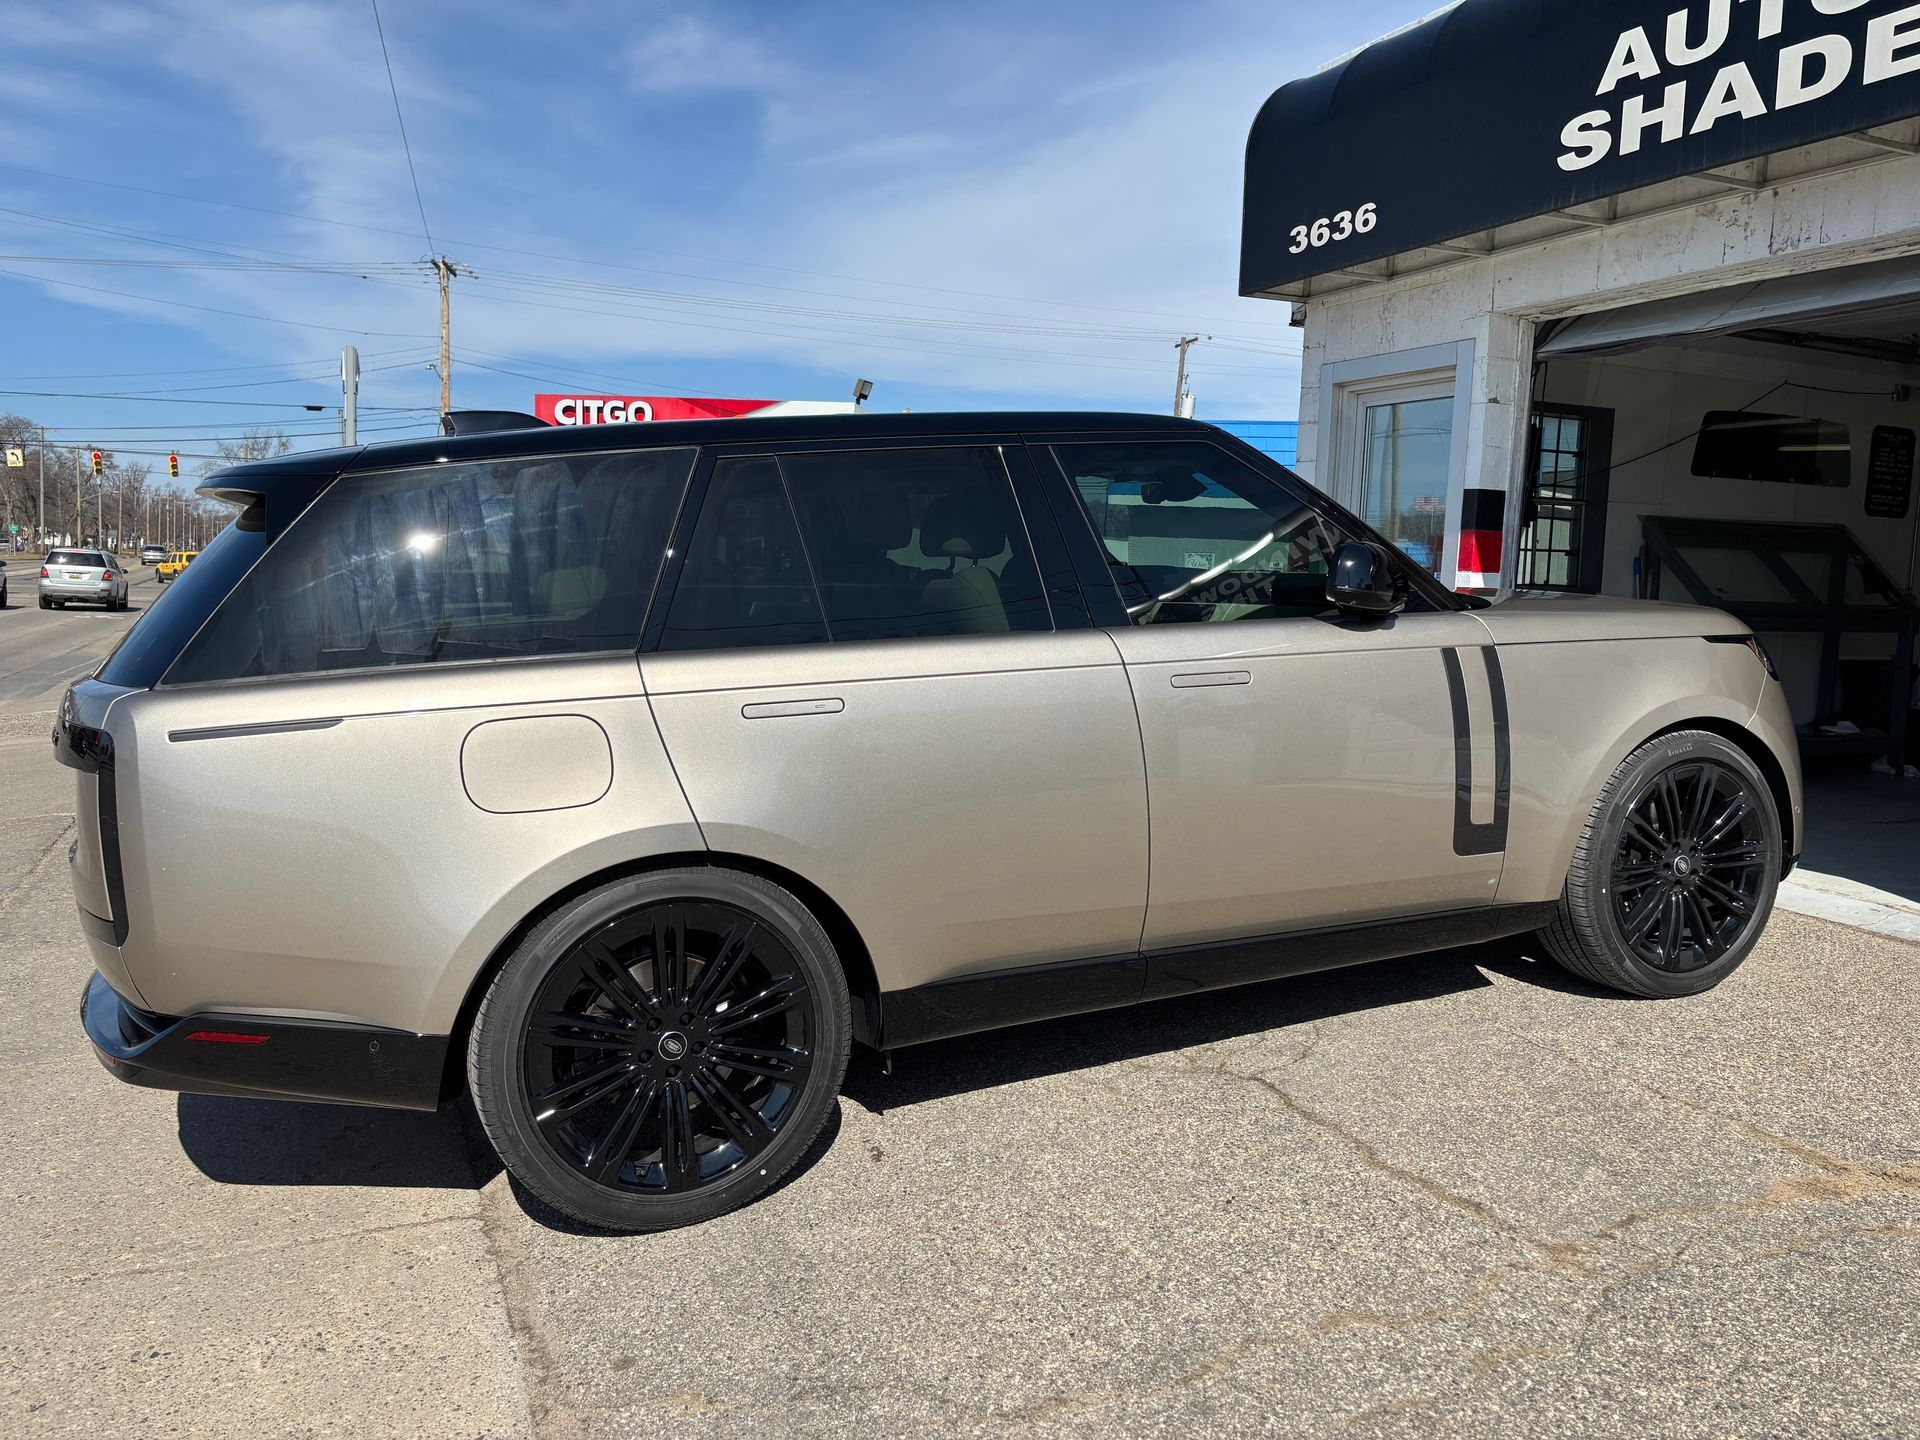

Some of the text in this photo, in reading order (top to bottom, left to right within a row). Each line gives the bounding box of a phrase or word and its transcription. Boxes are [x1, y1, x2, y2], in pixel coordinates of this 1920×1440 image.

[1595, 0, 1871, 96] AUT
[1556, 4, 1920, 171] SHADE
[1288, 202, 1377, 254] 3636
[554, 399, 654, 426] CITGO
